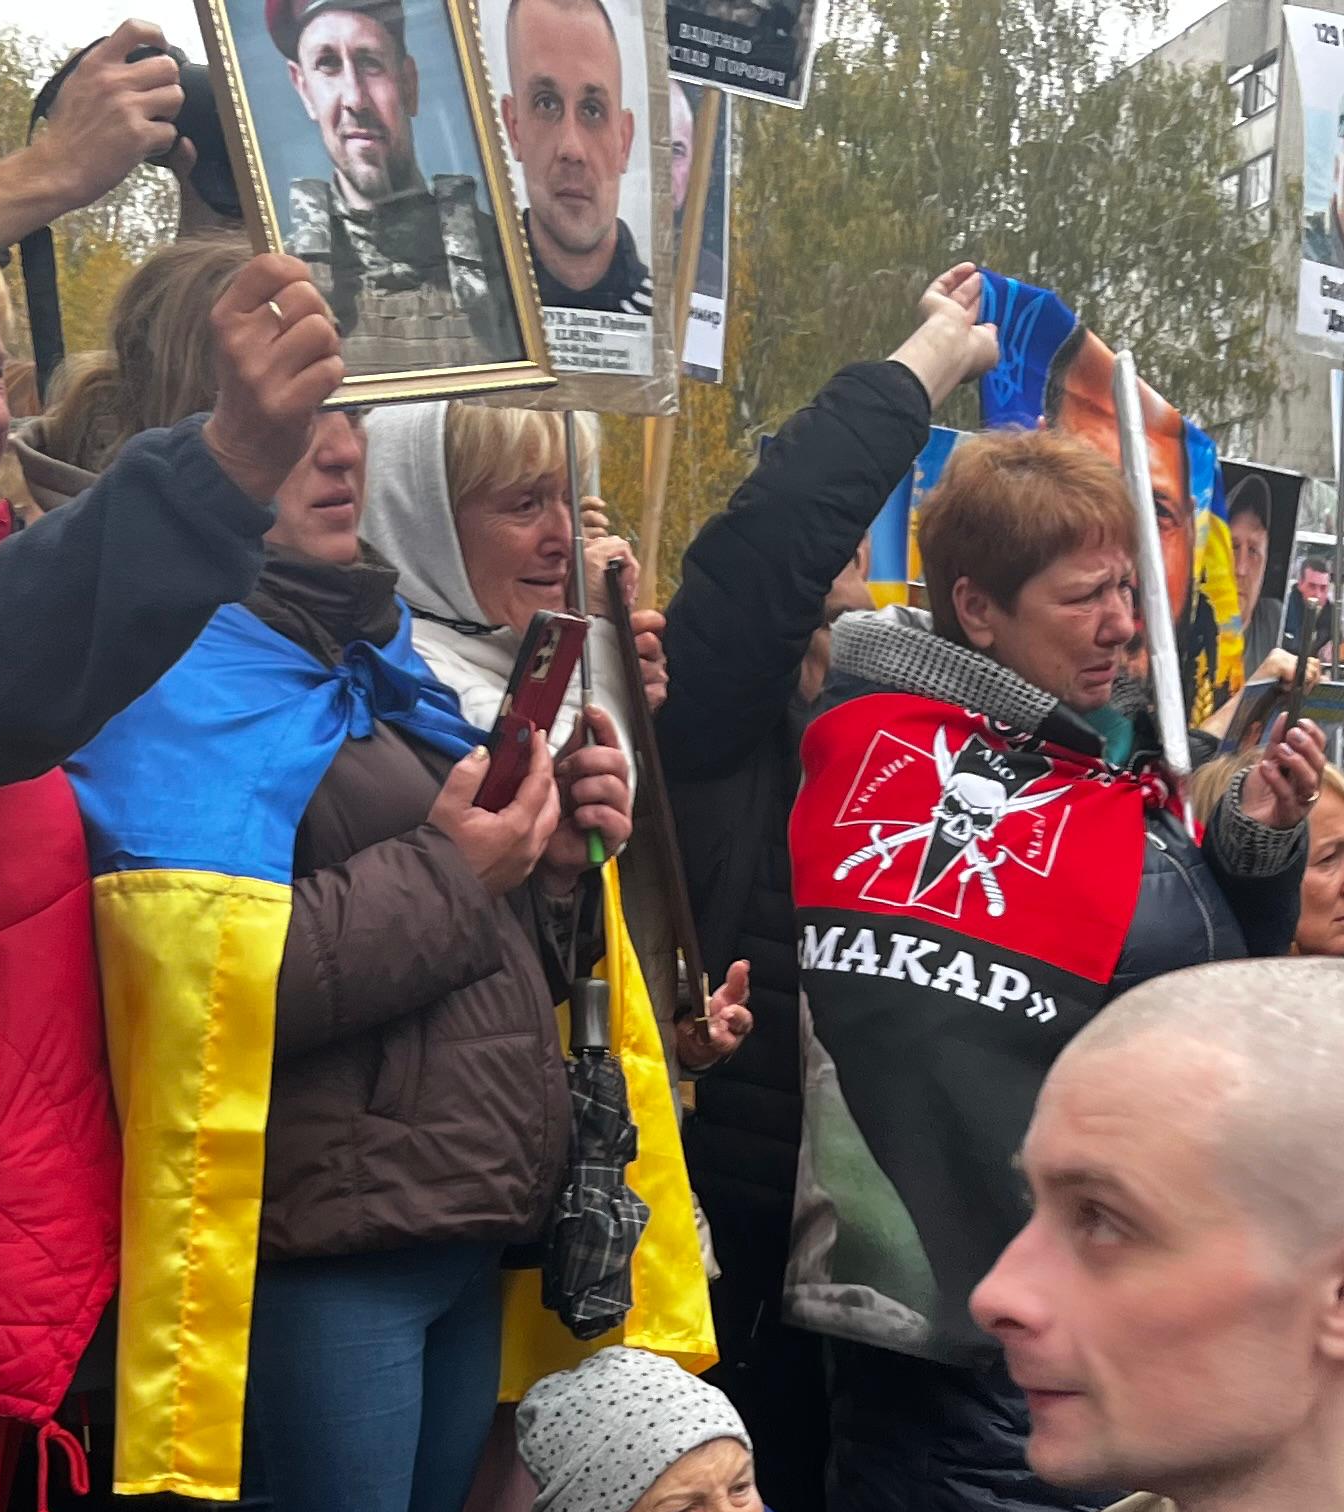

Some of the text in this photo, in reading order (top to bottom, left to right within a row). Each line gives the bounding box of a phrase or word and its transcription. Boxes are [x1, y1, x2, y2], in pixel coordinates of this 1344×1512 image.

[670, 46, 710, 68] СЛАВ
[850, 753, 916, 815] УКРАЇНА
[798, 925, 1058, 1023] МАКАР»
